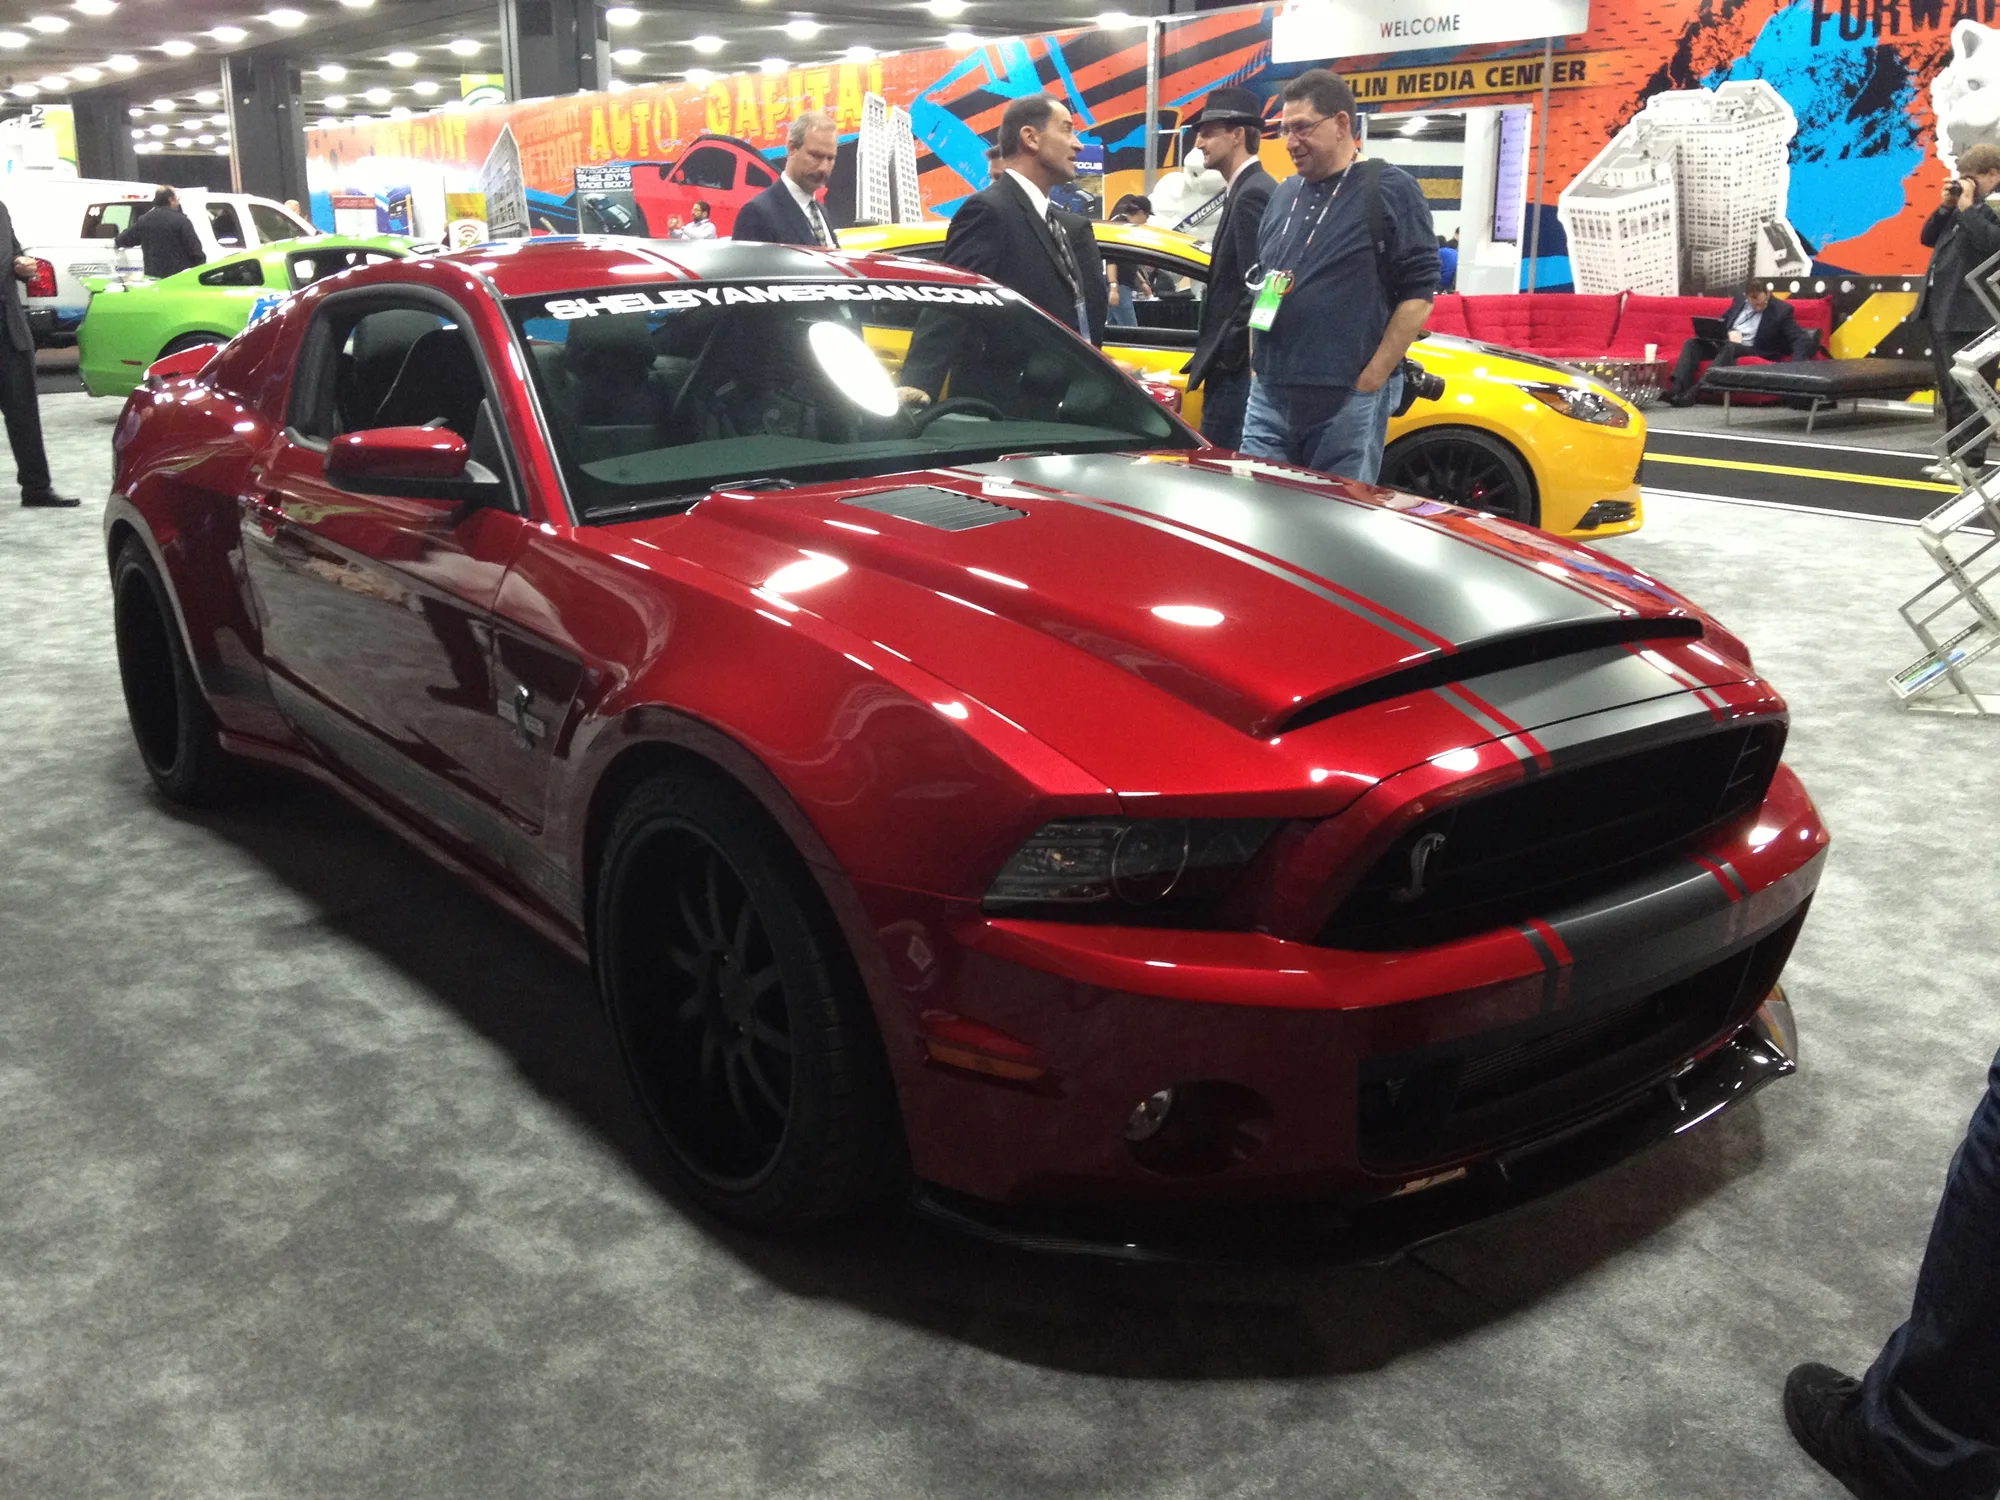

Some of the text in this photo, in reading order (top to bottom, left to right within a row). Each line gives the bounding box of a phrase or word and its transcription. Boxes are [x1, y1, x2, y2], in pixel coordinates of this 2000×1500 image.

[1380, 15, 1460, 38] WELCOME
[1346, 60, 1586, 97] LIN MEDIA CENTER
[590, 95, 678, 161] AUTO
[577, 173, 632, 182] SHELBY'S
[577, 180, 632, 189] WIDE BODY
[545, 284, 1004, 320] SHELBYAMERICAN.COM
